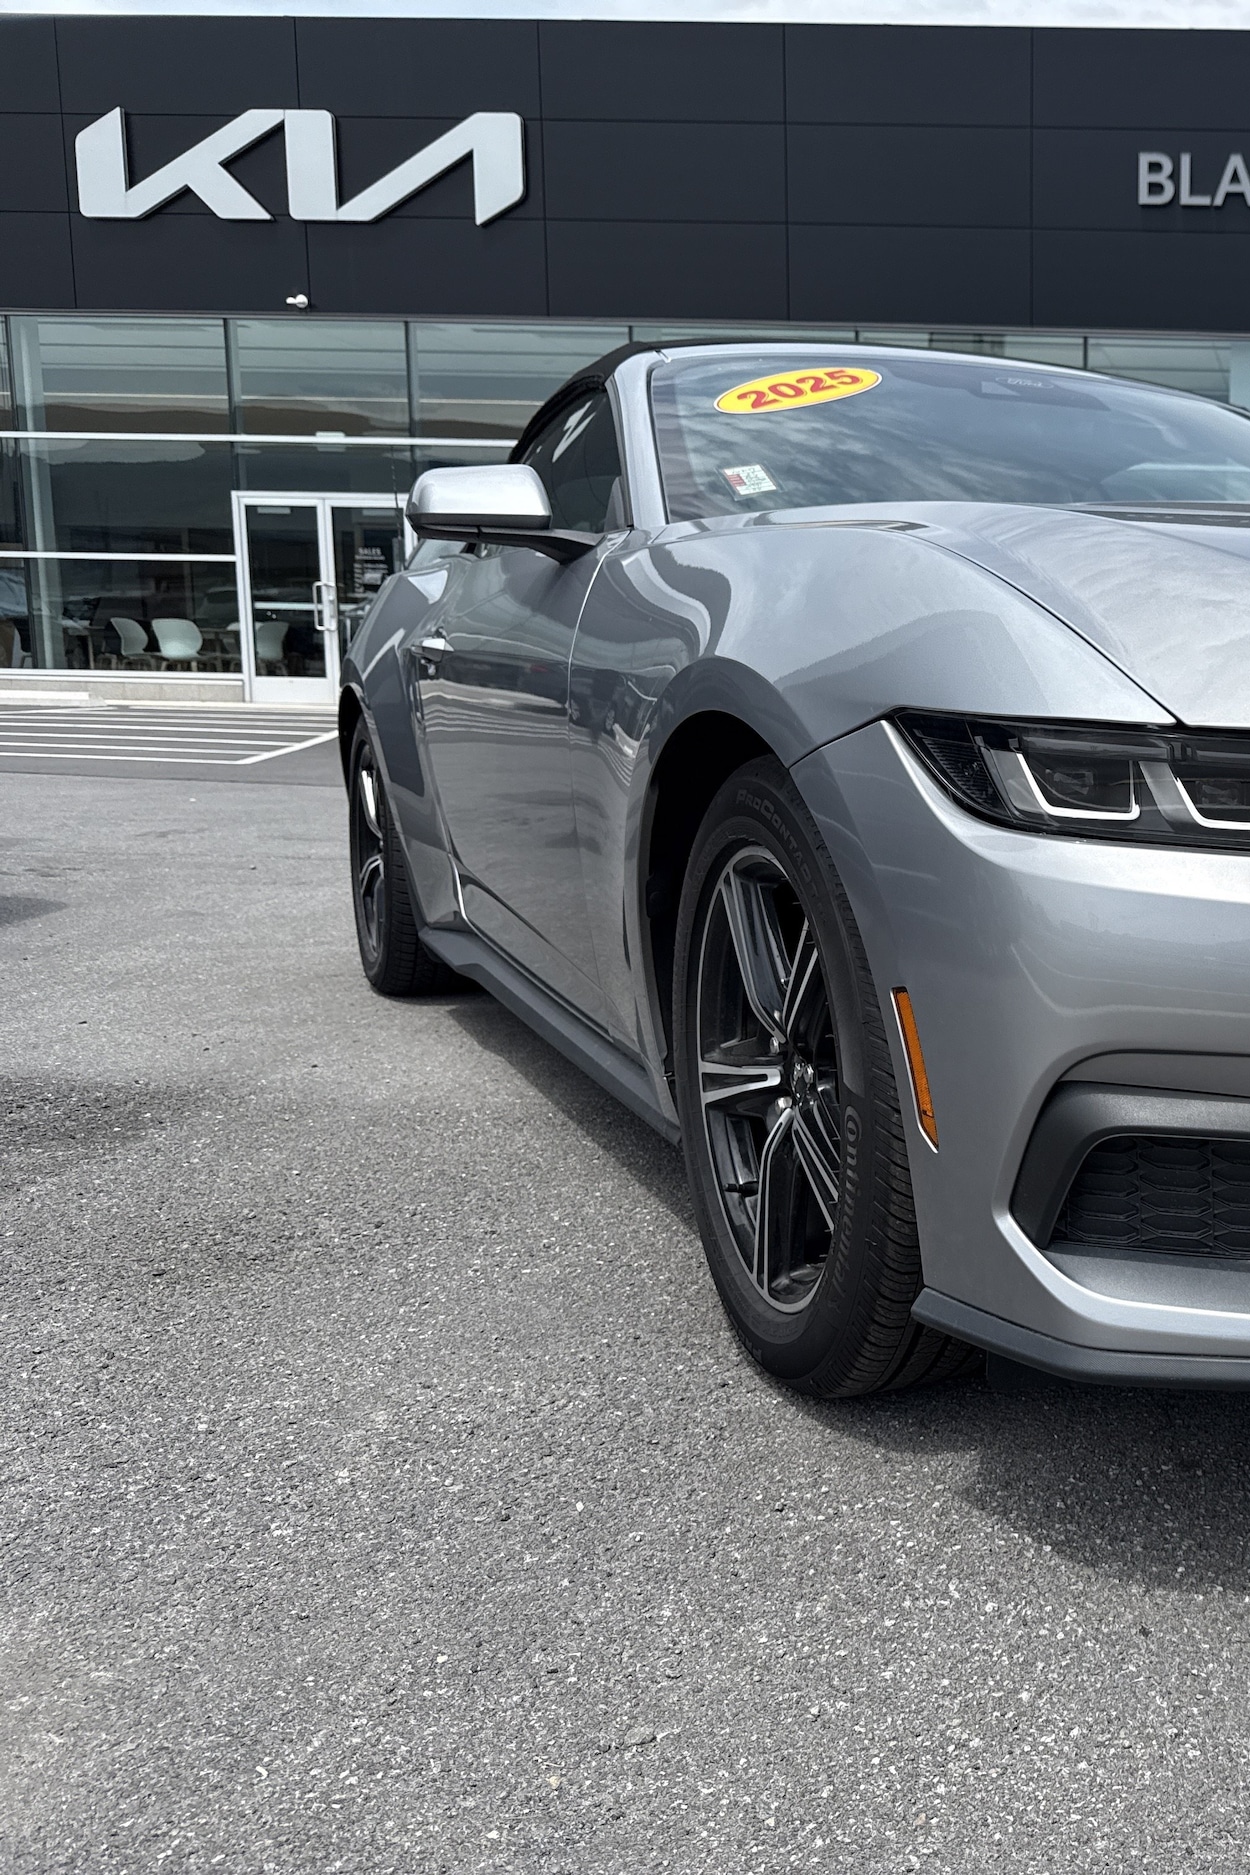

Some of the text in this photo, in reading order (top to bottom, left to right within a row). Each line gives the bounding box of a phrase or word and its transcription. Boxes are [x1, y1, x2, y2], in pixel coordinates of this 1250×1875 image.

[75, 106, 527, 226] KIA
[737, 370, 863, 410] 2025
[359, 547, 382, 555] SALES
[832, 1105, 863, 1298] Continental
